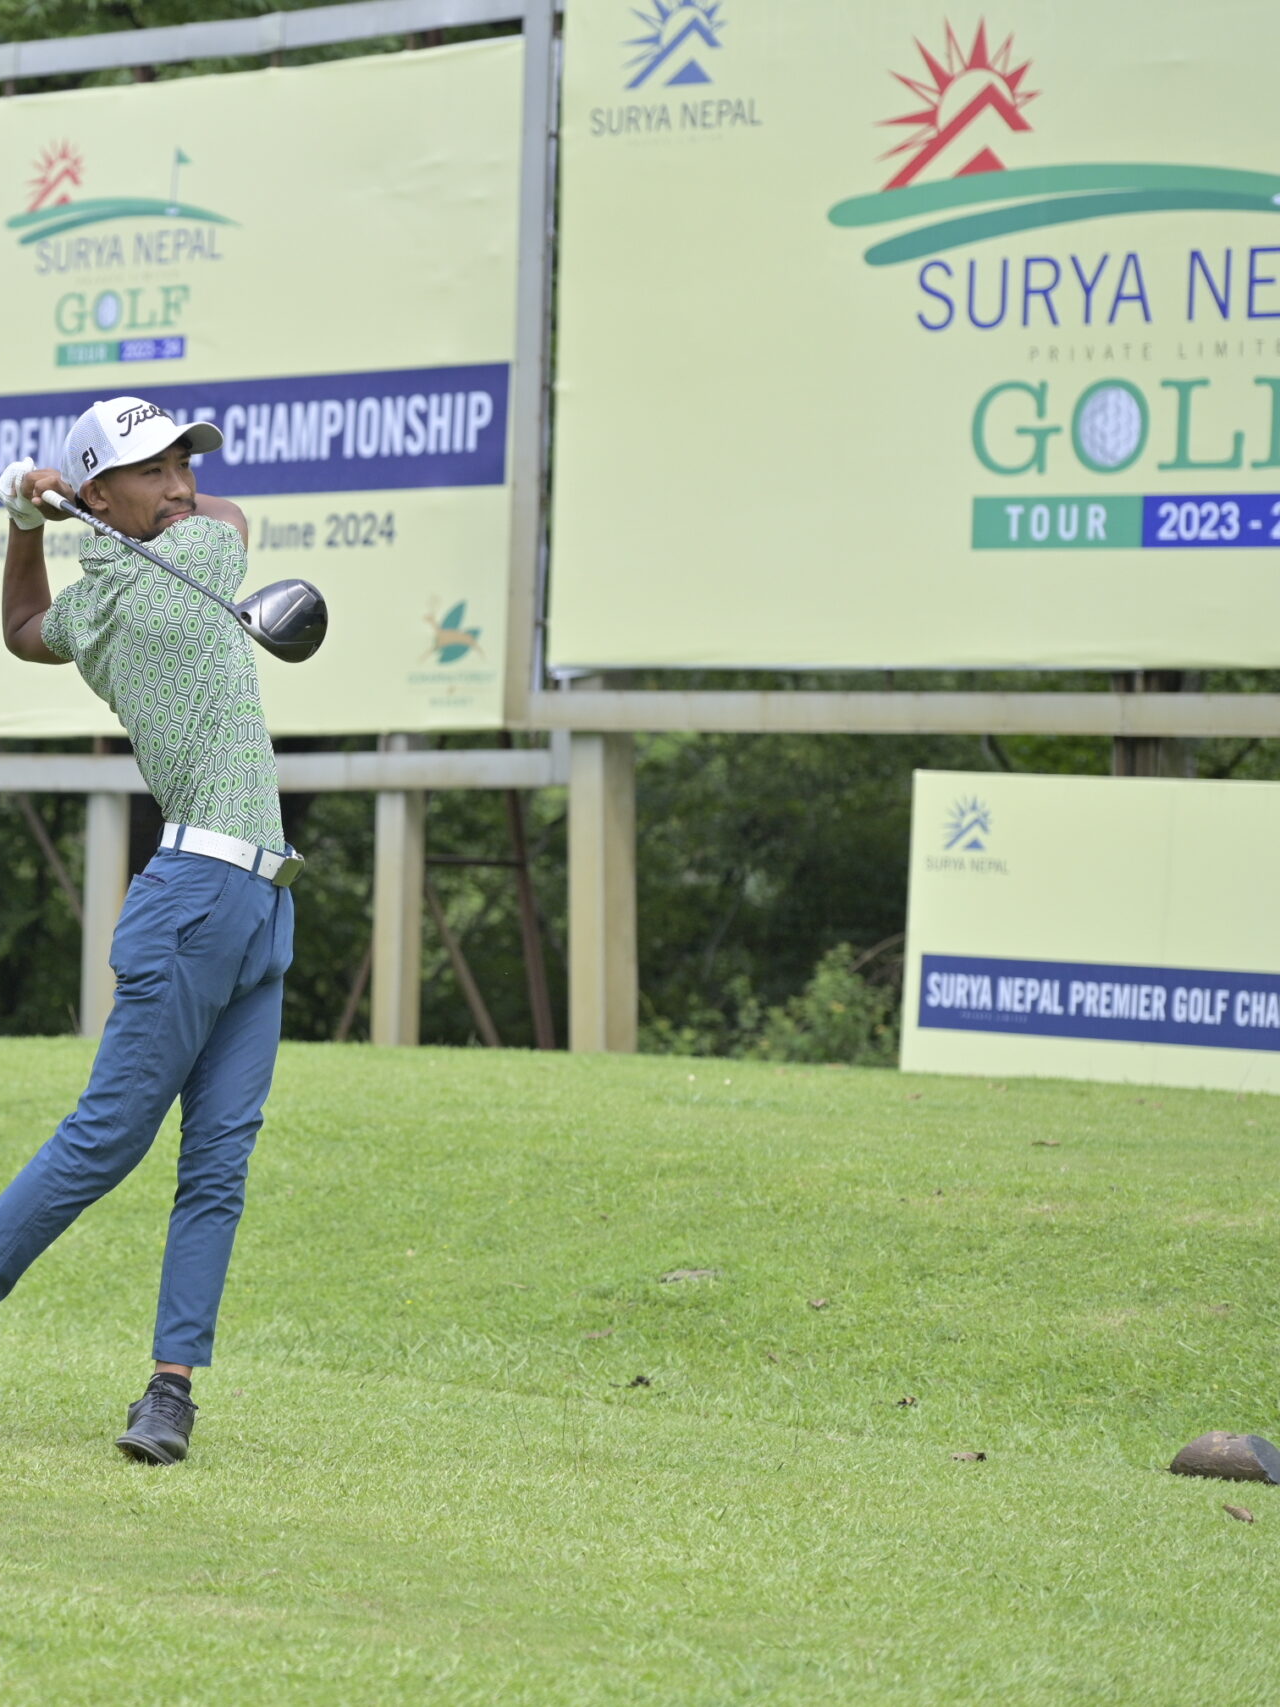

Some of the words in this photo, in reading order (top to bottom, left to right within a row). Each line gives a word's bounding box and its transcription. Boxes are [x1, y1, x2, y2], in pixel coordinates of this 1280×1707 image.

[590, 104, 672, 137] SURYA
[679, 98, 763, 129] NEPAL
[35, 235, 125, 276] SURYA
[133, 228, 223, 265] NEPAL
[54, 284, 190, 336] GOLF
[916, 251, 1153, 333] SURYA
[1028, 343, 1153, 362] PRIVATE
[222, 390, 493, 466] CHAMPIONSHIP
[81, 447, 98, 473] FJ
[257, 516, 315, 550] June
[325, 512, 397, 548] 2024
[1005, 503, 1107, 541] TOUR
[924, 854, 966, 873] SURYA
[970, 856, 1009, 876] NEPAL
[926, 971, 993, 1011] SURYA
[997, 976, 1064, 1016] NEPAL
[1069, 980, 1167, 1022] PREMIER
[1173, 986, 1229, 1025] GOLF
